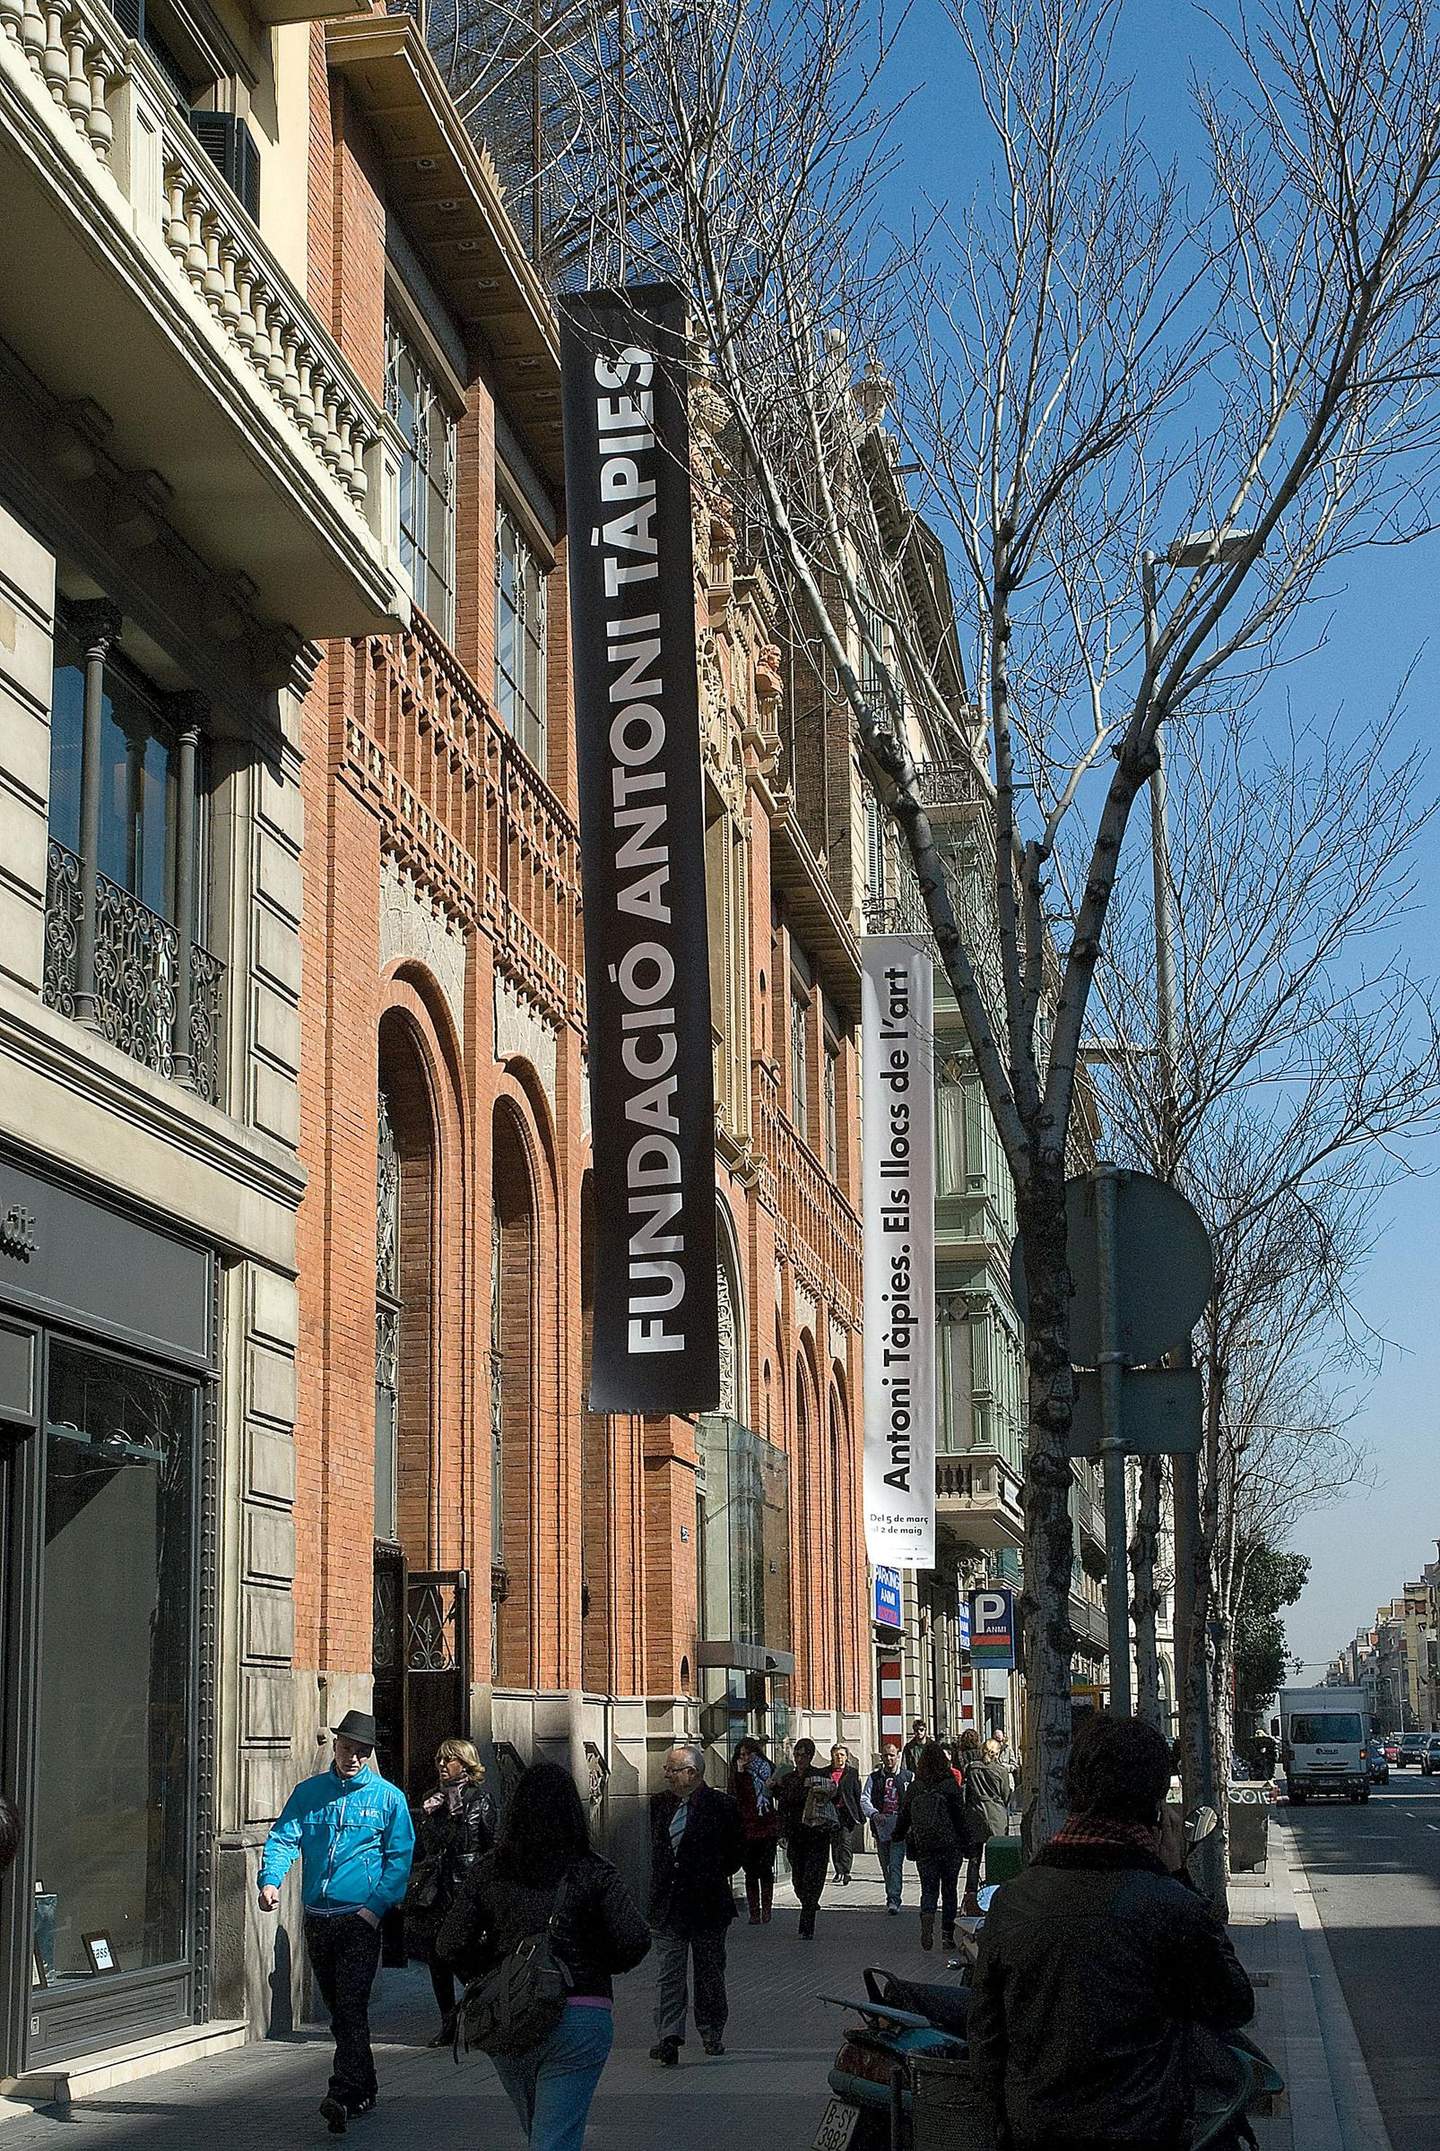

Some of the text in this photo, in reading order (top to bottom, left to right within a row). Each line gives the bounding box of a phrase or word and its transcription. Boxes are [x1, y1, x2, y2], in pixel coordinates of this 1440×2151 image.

[590, 345, 686, 1354] FUNDACIÓ ANTONI TÀPIES
[879, 1049, 910, 1093] de
[879, 1102, 910, 1178] llocs
[879, 1188, 910, 1233] Els
[881, 1244, 919, 1368] Tàpies.
[881, 1377, 911, 1494] Antoni
[870, 1513, 929, 1525] Del 5 de març
[880, 1526, 886, 1534] 2
[887, 1526, 899, 1534] de
[900, 1526, 923, 1536] maig
[975, 1593, 1005, 1634] P
[985, 1626, 1007, 1634] ANMI
